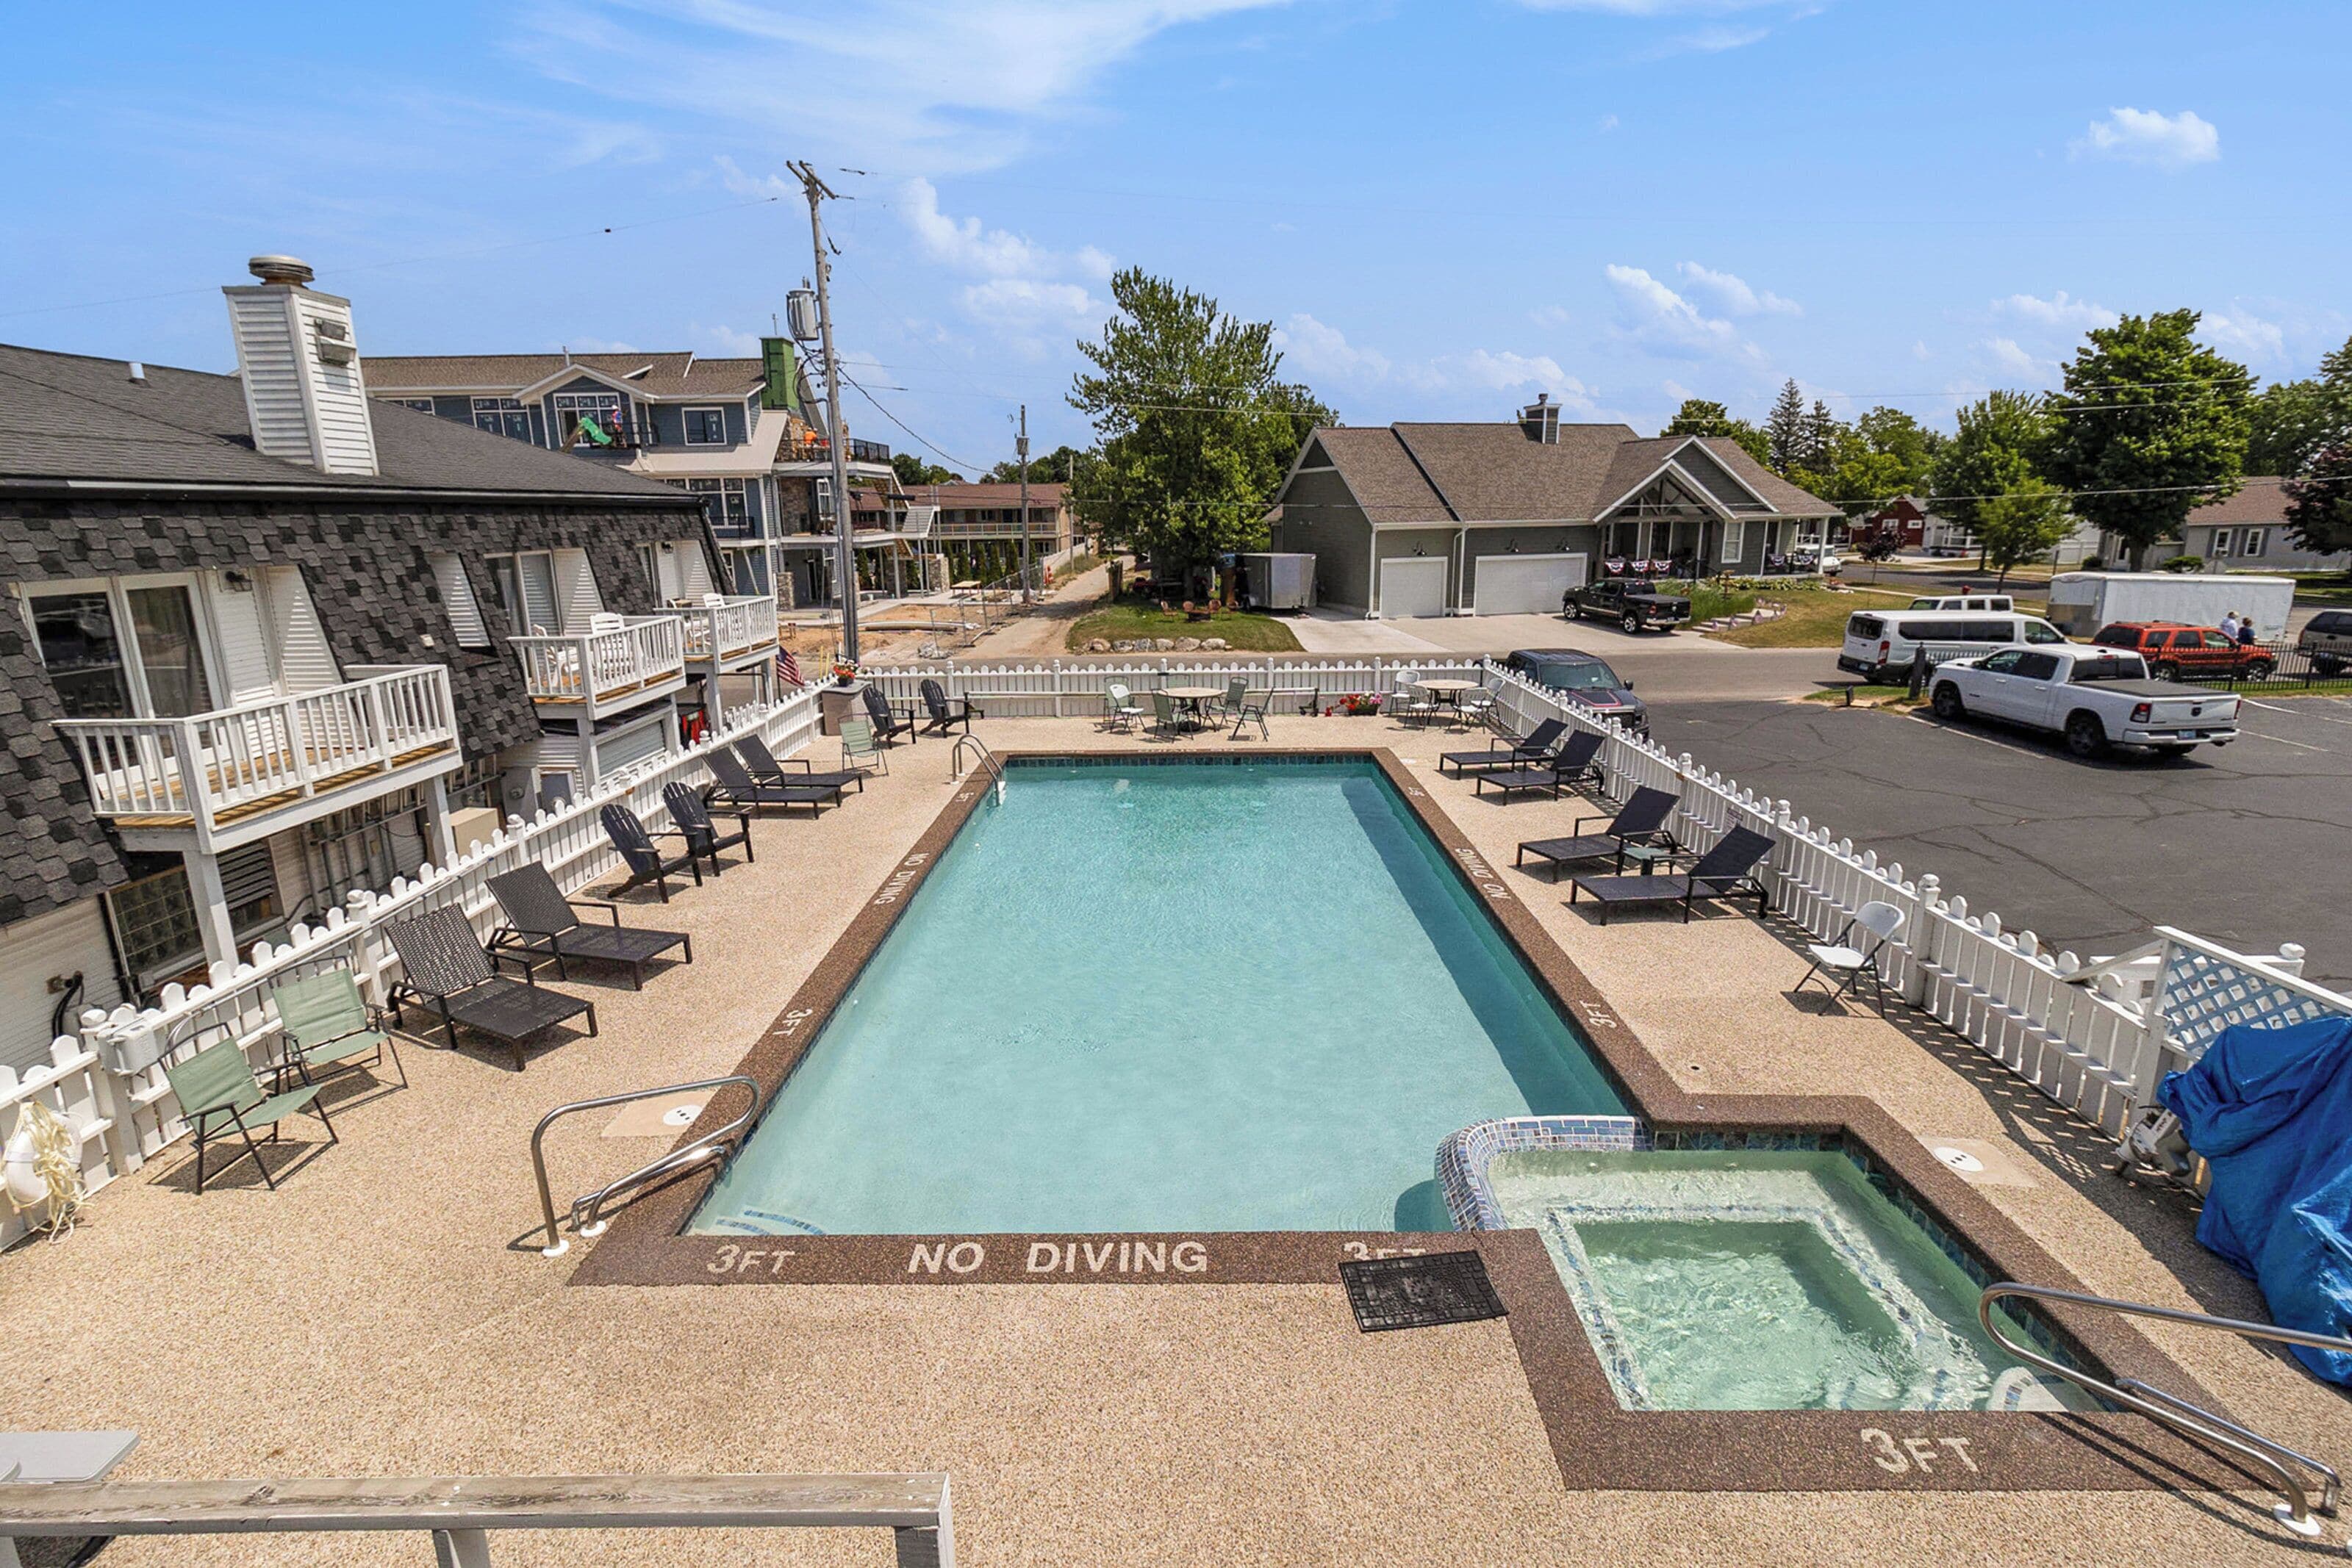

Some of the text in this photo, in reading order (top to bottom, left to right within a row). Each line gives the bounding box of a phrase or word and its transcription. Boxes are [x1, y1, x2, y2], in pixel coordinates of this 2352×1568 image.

[874, 853, 930, 904] NO DIVING
[1455, 848, 1511, 899] NO DIVING
[772, 1009, 813, 1036] 3FT
[1579, 1000, 1617, 1028] 3FT
[706, 1244, 796, 1274] 3FT
[907, 1241, 1208, 1273] NO DIVING
[1860, 1428, 1980, 1473] 3FT
